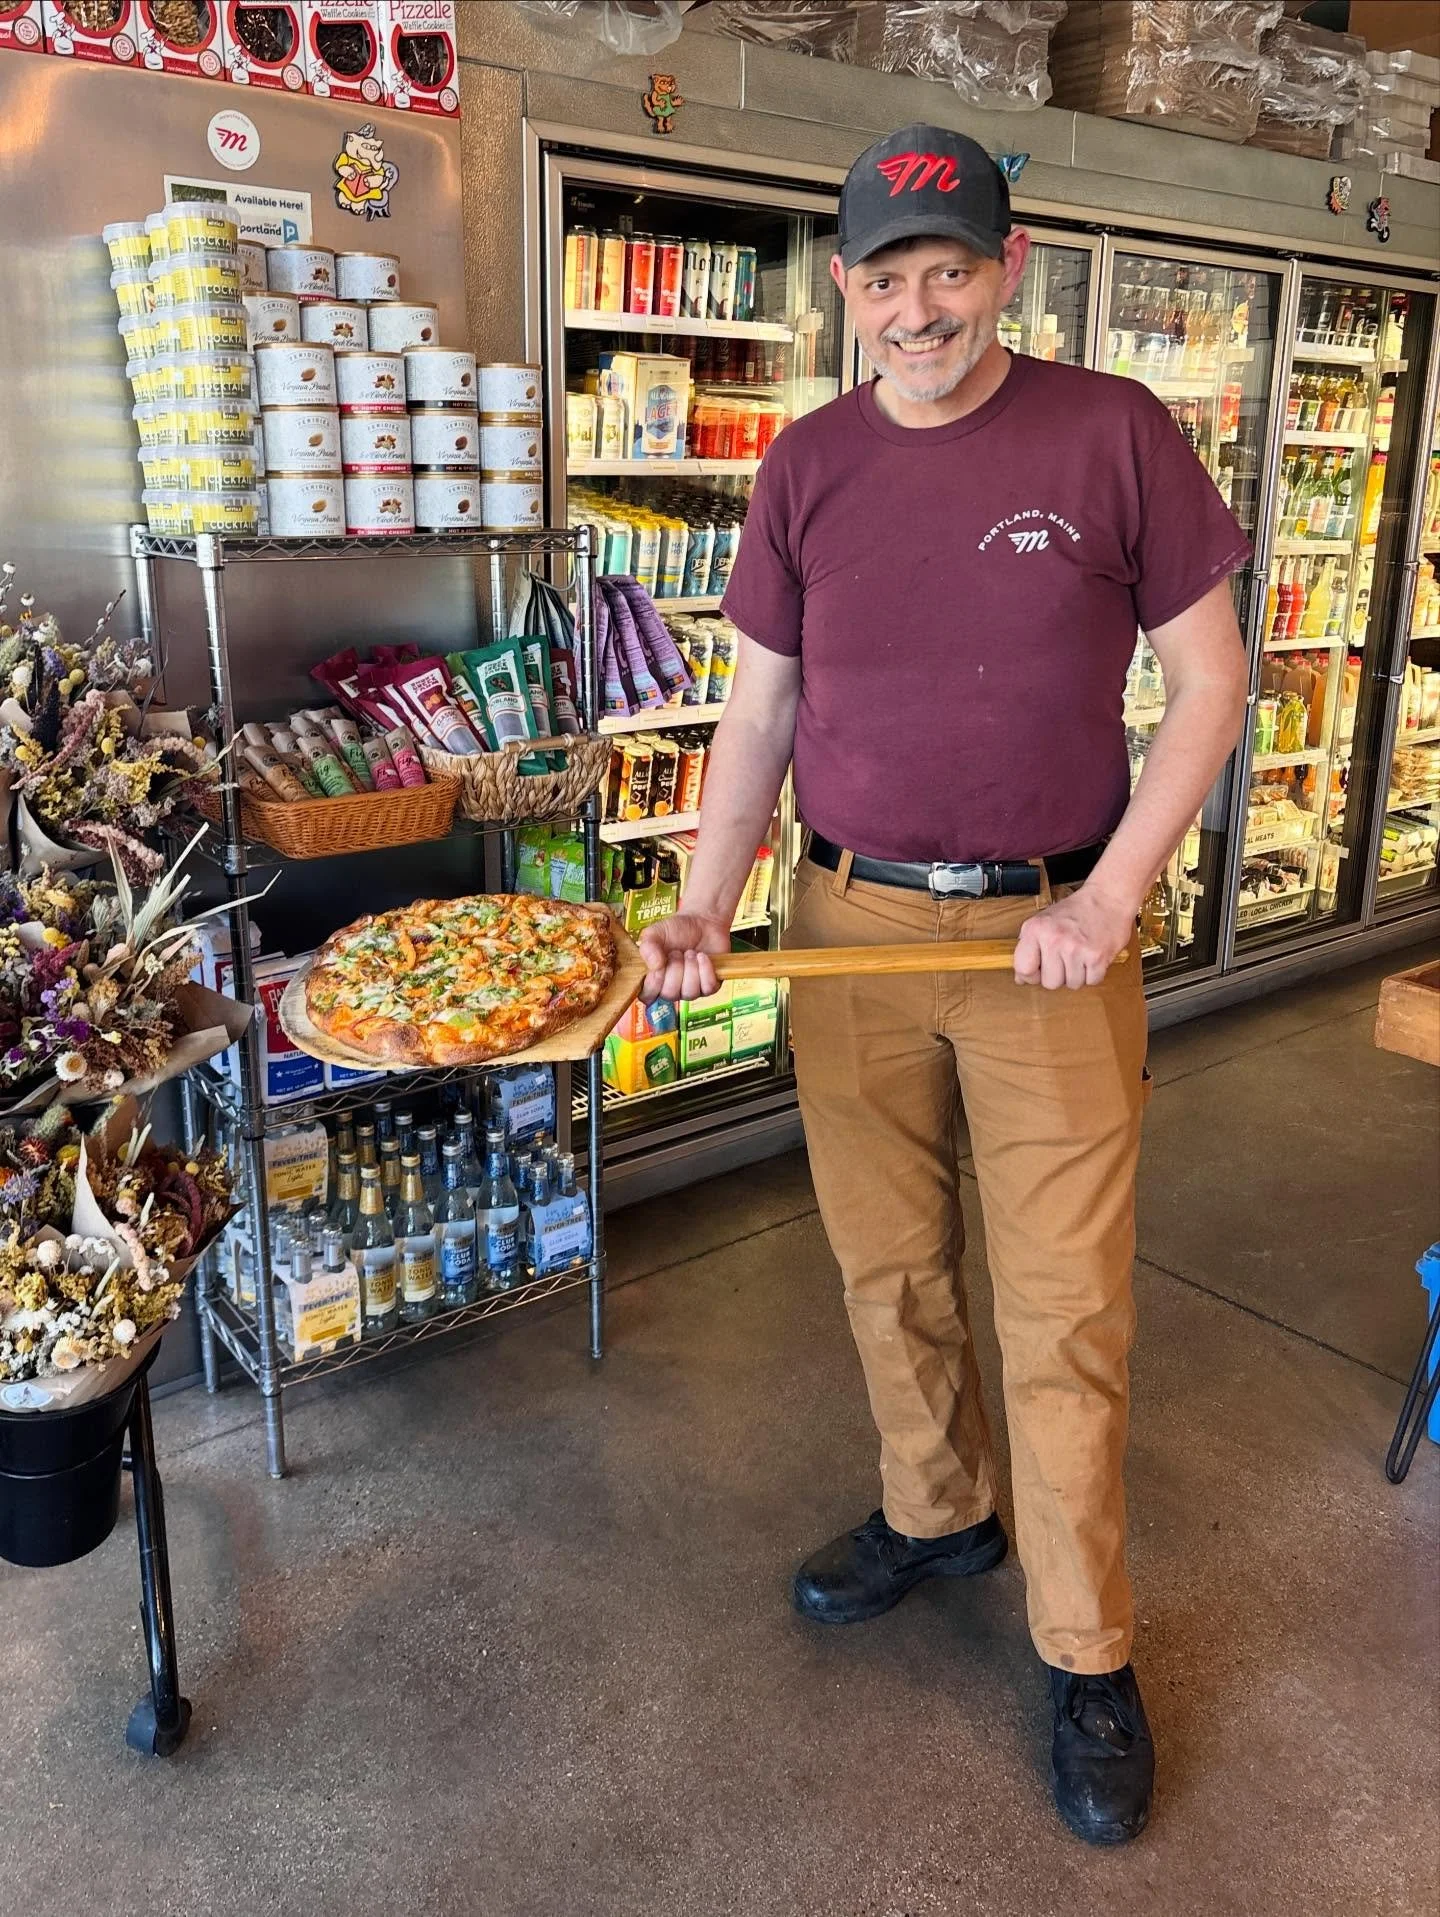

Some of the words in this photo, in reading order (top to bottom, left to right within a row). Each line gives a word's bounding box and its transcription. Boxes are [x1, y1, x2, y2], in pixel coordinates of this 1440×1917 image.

[321, 9, 343, 19] Waffle
[343, 9, 367, 18] Cookies
[389, 0, 452, 20] Pizzelle
[402, 21, 423, 30] Waffle
[423, 21, 446, 30] Cookies
[235, 194, 278, 208] Available
[279, 200, 304, 210] Here!
[240, 223, 282, 236] portland
[210, 521, 254, 530] COCKTAIL
[978, 509, 1044, 551] PORTLAND,
[1048, 512, 1081, 542] MAINE
[1255, 832, 1275, 842] MEATS
[1251, 906, 1268, 916] LOCAL
[1269, 898, 1293, 911] CHICKEN
[636, 905, 673, 921] TRIPEL
[689, 1036, 708, 1051] IPA
[496, 1236, 515, 1246] CLUB
[495, 1243, 515, 1252] SODA
[450, 1251, 471, 1260] CLUB
